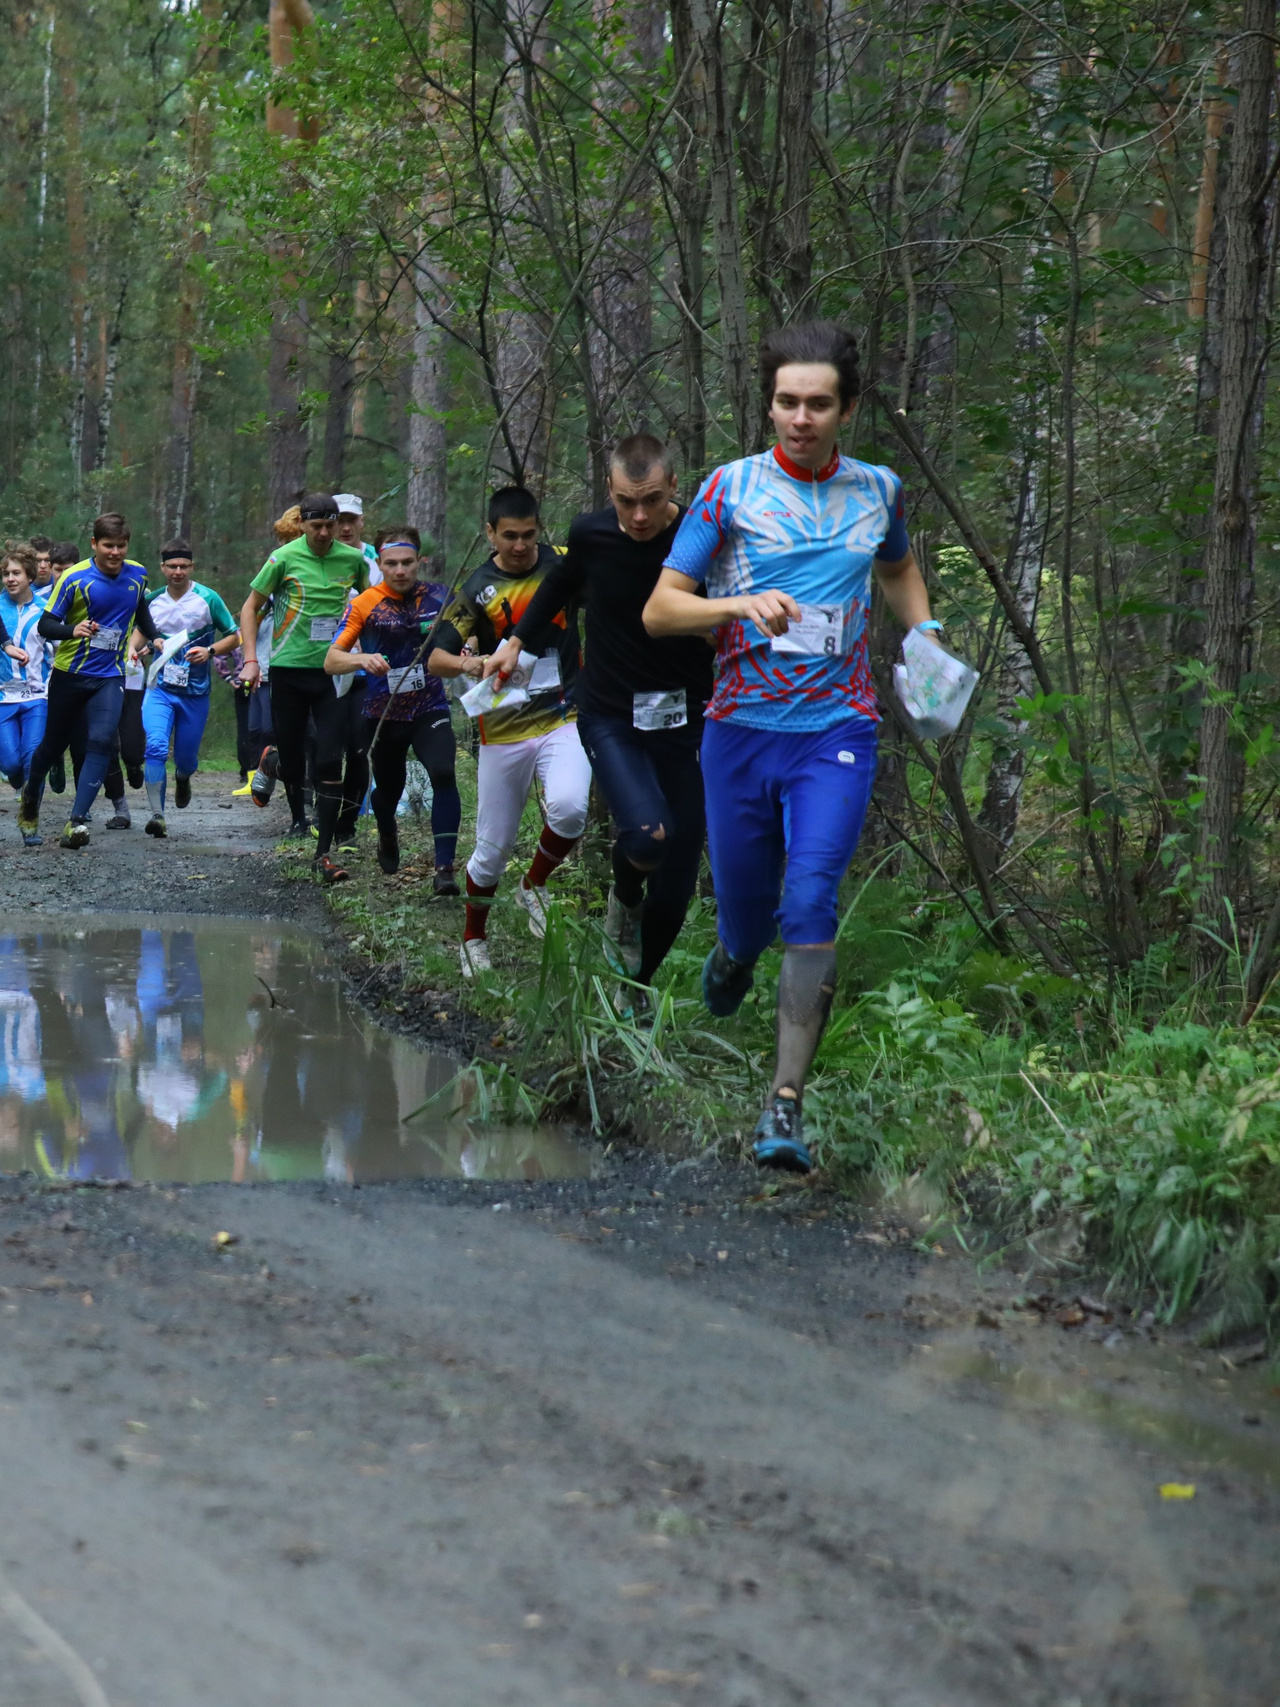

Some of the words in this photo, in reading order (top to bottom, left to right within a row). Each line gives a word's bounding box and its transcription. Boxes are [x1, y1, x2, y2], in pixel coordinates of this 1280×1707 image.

[824, 635, 836, 657] 8
[411, 680, 423, 690] 16
[663, 711, 683, 726] 20
